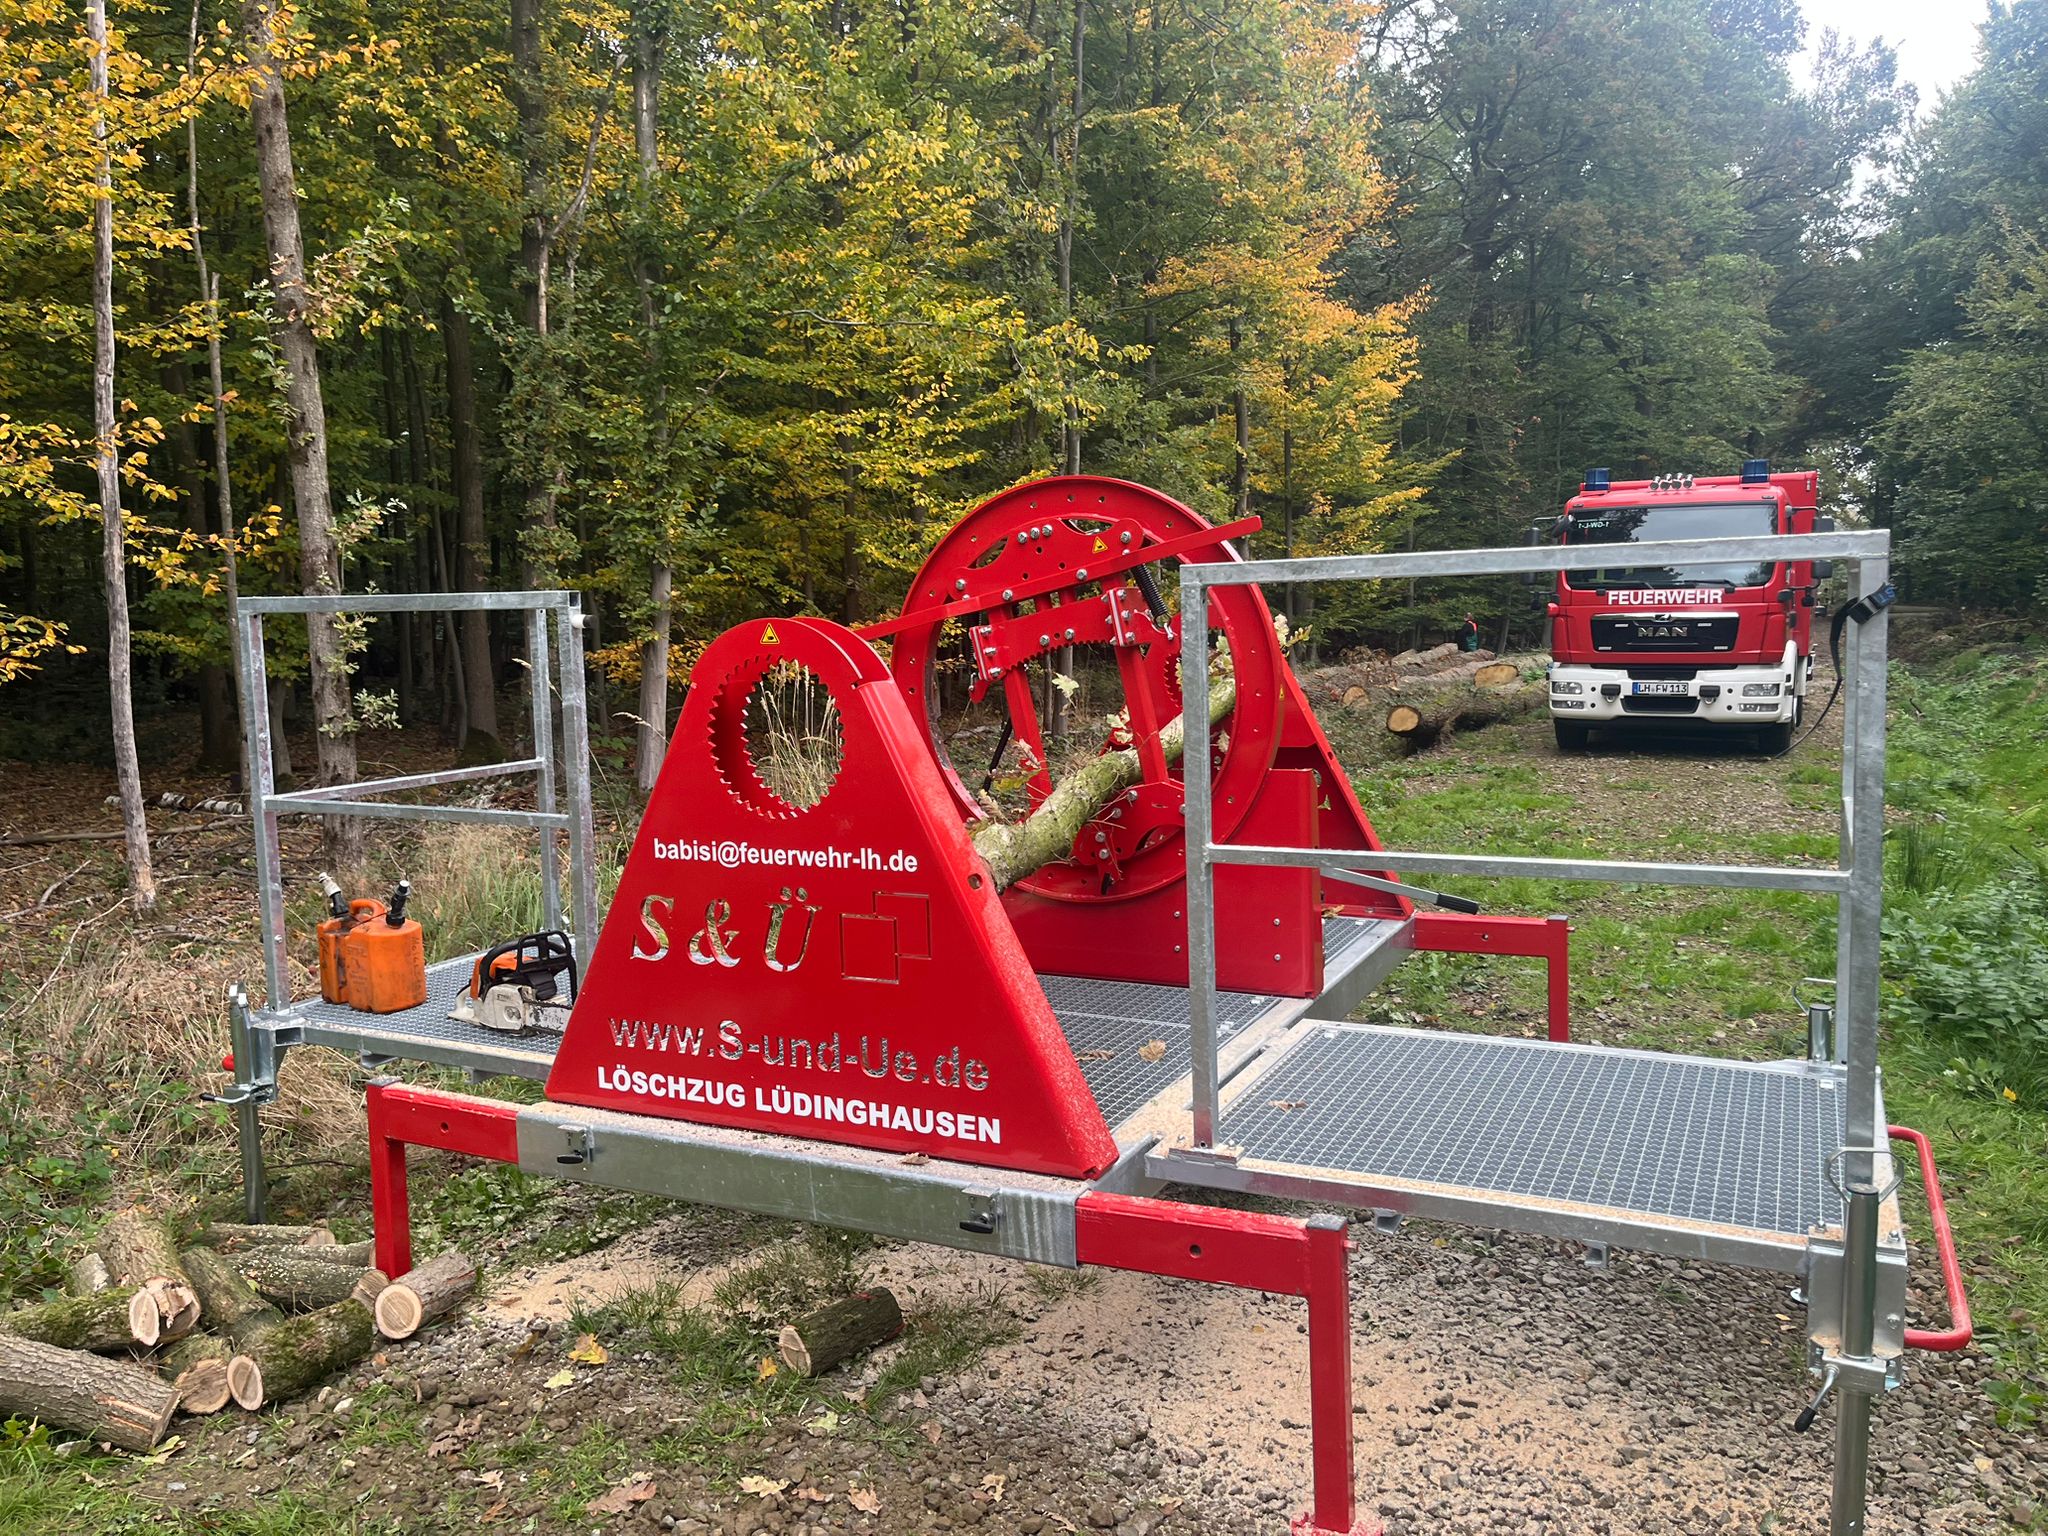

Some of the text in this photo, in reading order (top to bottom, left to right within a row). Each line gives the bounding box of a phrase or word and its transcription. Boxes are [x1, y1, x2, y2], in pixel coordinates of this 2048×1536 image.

[1607, 590, 1723, 605] FEUERWEHR
[1637, 626, 1688, 637] MAN
[1638, 684, 1687, 693] LH FW 113
[653, 838, 918, 872] babisi@feuerwehr-lh.de
[630, 886, 823, 972] S & Ü
[608, 1018, 990, 1091] www.S-und-Ue.de
[596, 1064, 1001, 1144] LÖSCHZUG LÜDINGHAUSEN
